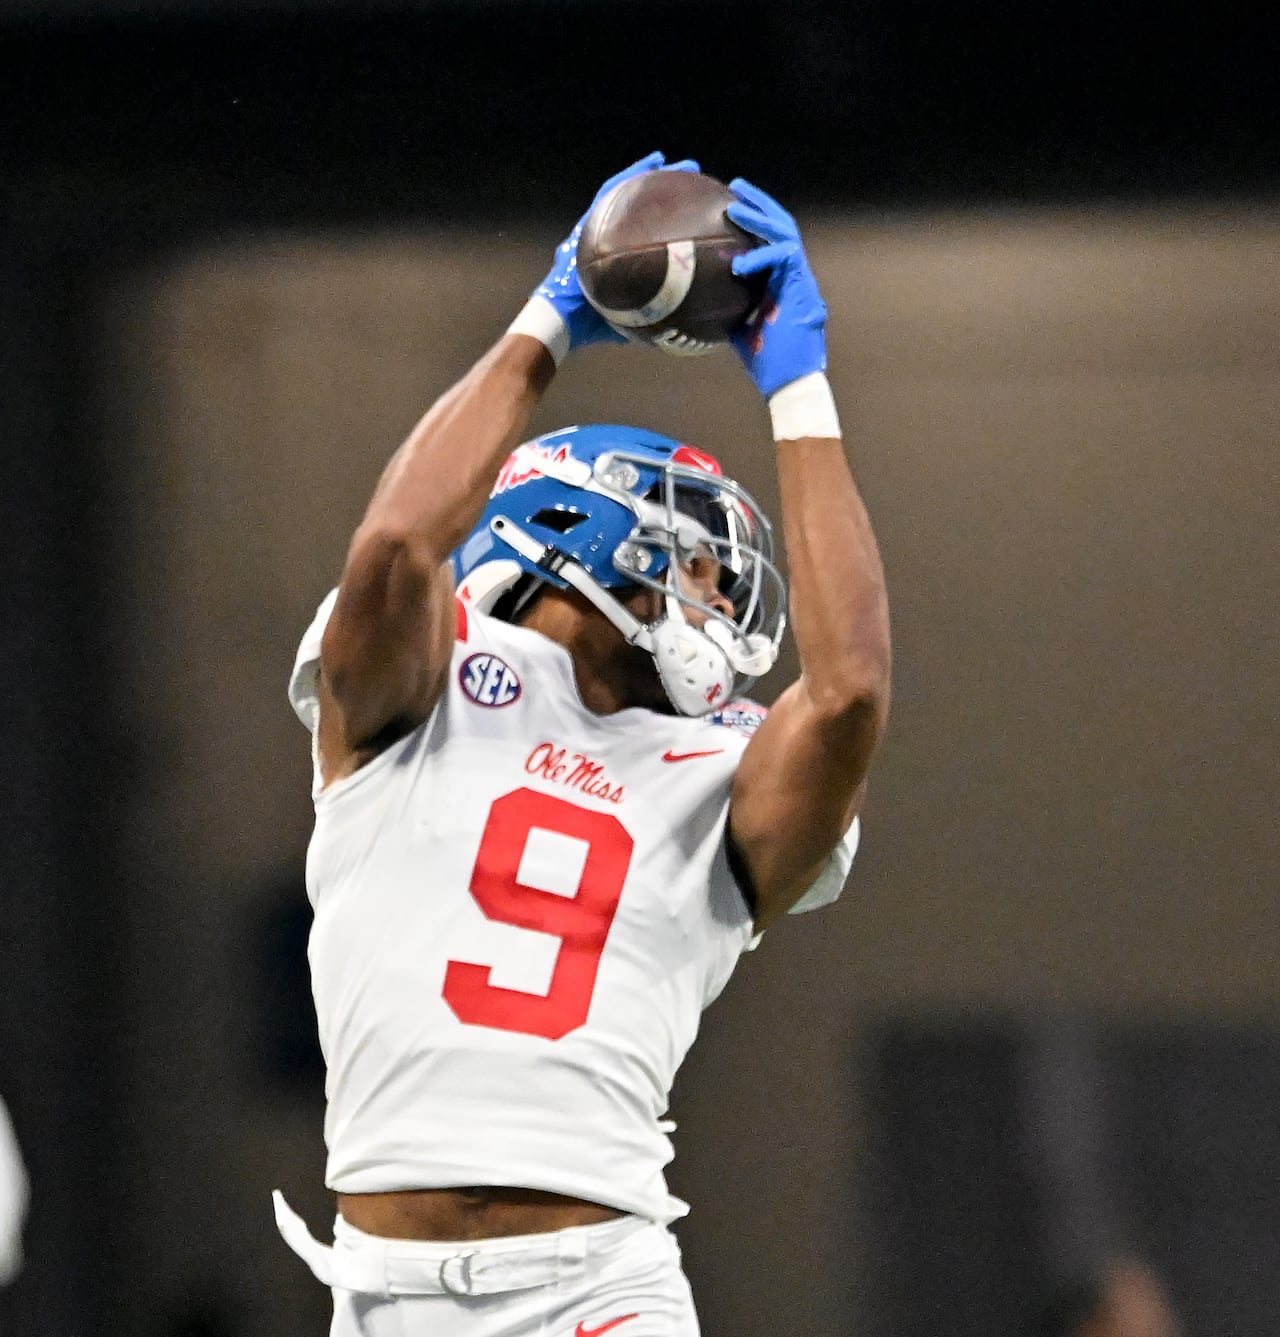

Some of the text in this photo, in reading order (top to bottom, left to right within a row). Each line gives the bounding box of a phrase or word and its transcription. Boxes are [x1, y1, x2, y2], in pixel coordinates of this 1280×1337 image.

[463, 655, 519, 704] SEC
[524, 741, 625, 804] Ole Miss
[441, 786, 634, 1042] 9
